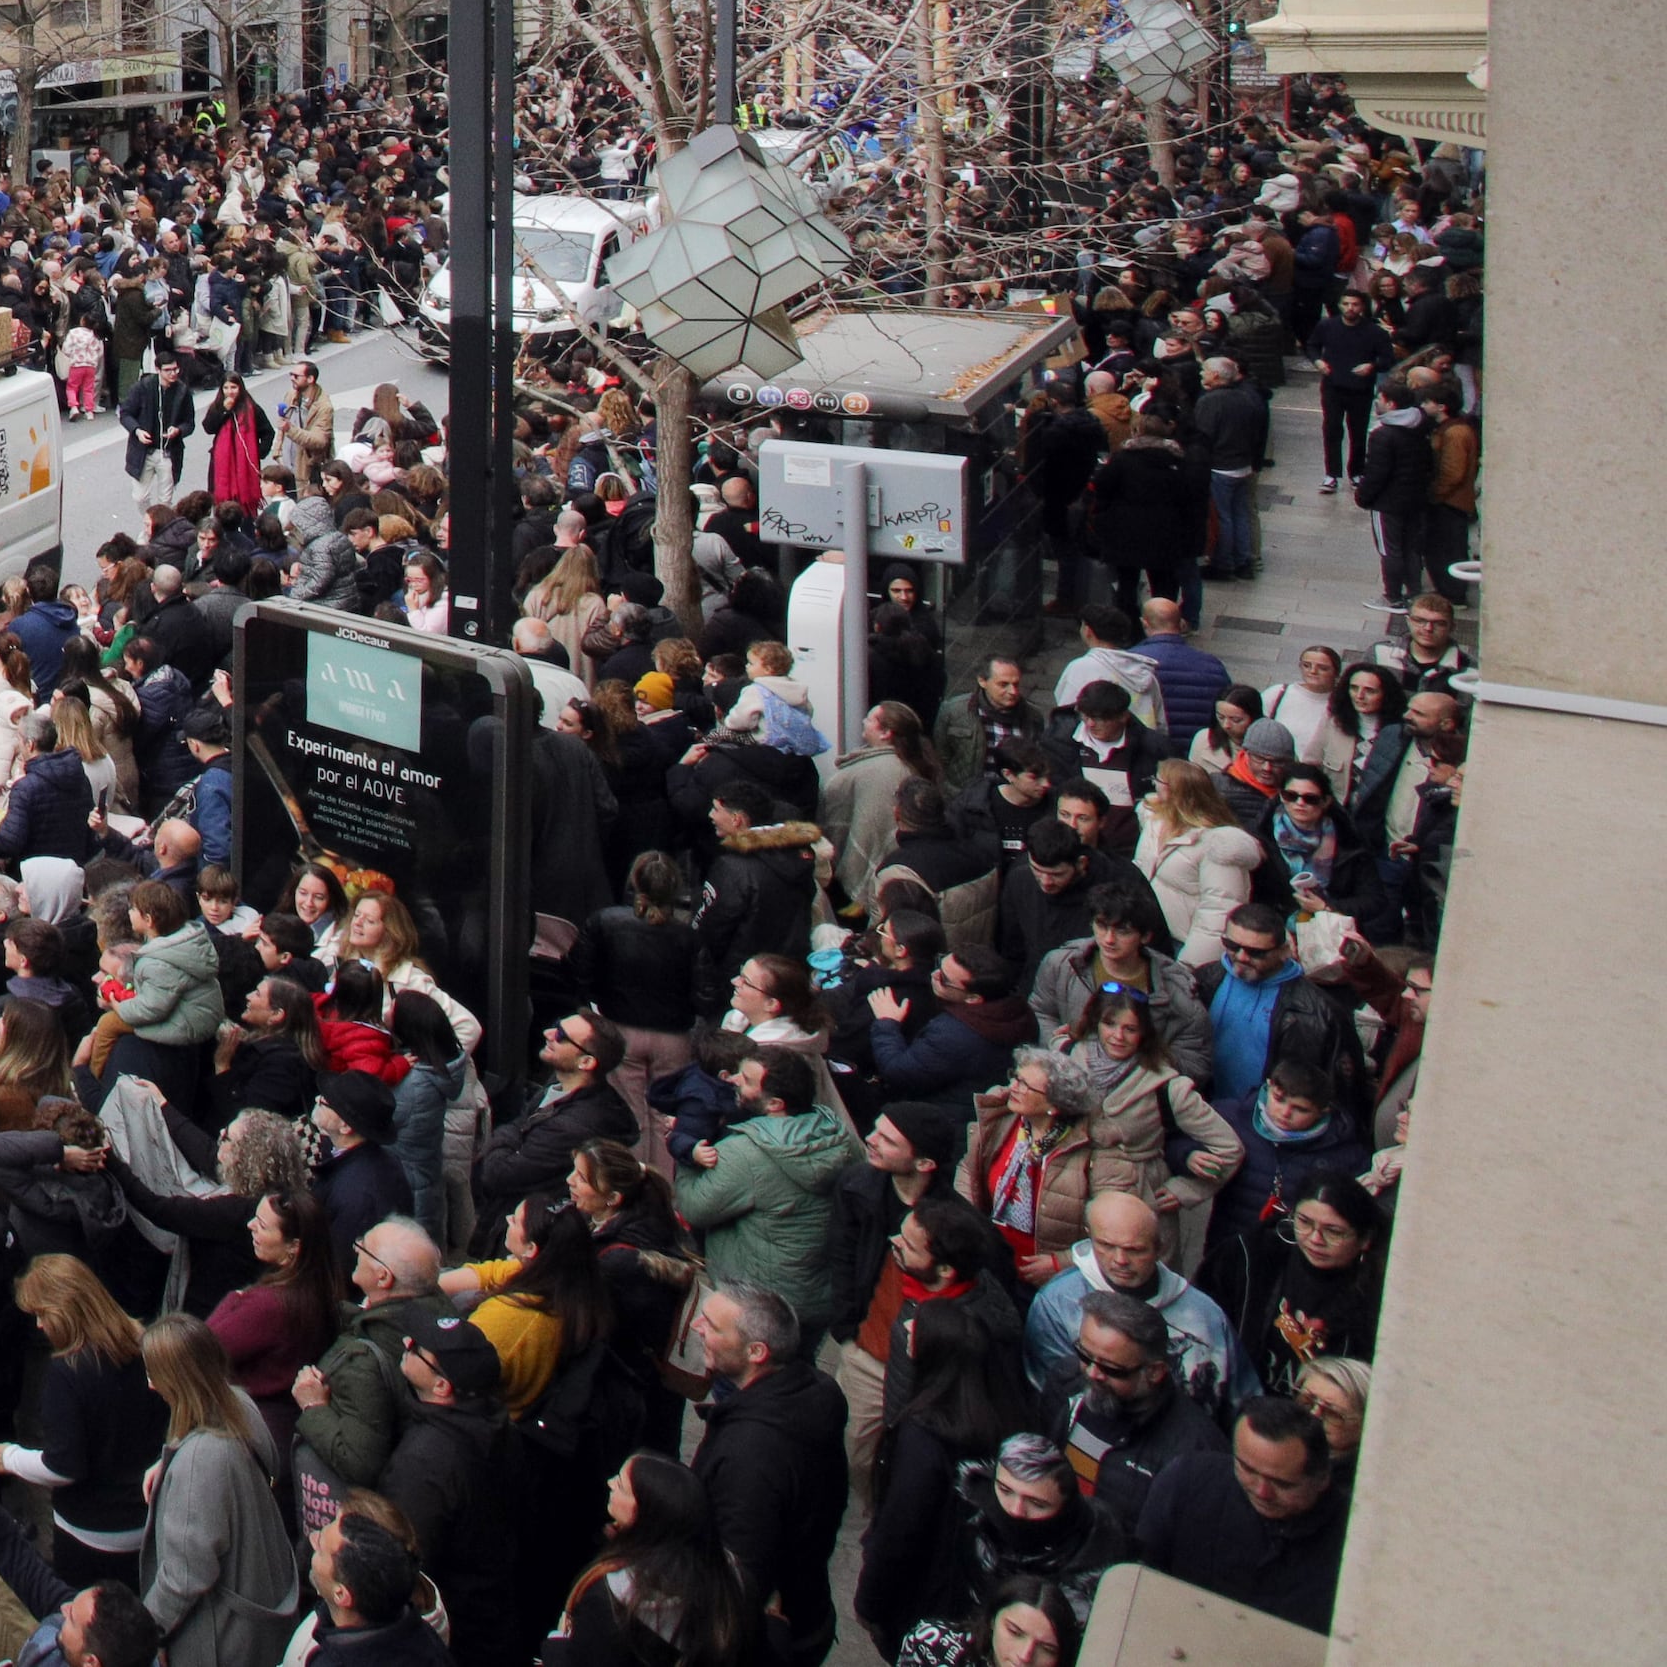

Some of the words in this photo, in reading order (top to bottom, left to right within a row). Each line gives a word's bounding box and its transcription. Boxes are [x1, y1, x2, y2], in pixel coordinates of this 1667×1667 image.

[762, 392, 777, 402] 11
[818, 397, 835, 407] 111
[847, 398, 863, 409] 21
[335, 626, 391, 650] JCDecaux
[287, 729, 378, 773] Experimenta
[381, 759, 395, 777] el
[399, 766, 442, 789] amor
[317, 766, 342, 785] por
[345, 773, 358, 791] el
[362, 777, 407, 805] AOVE.
[307, 788, 325, 800] Ama
[338, 796, 361, 811] forma
[362, 805, 417, 829] incondicional,
[357, 826, 388, 841] primera
[300, 1472, 330, 1496] the
